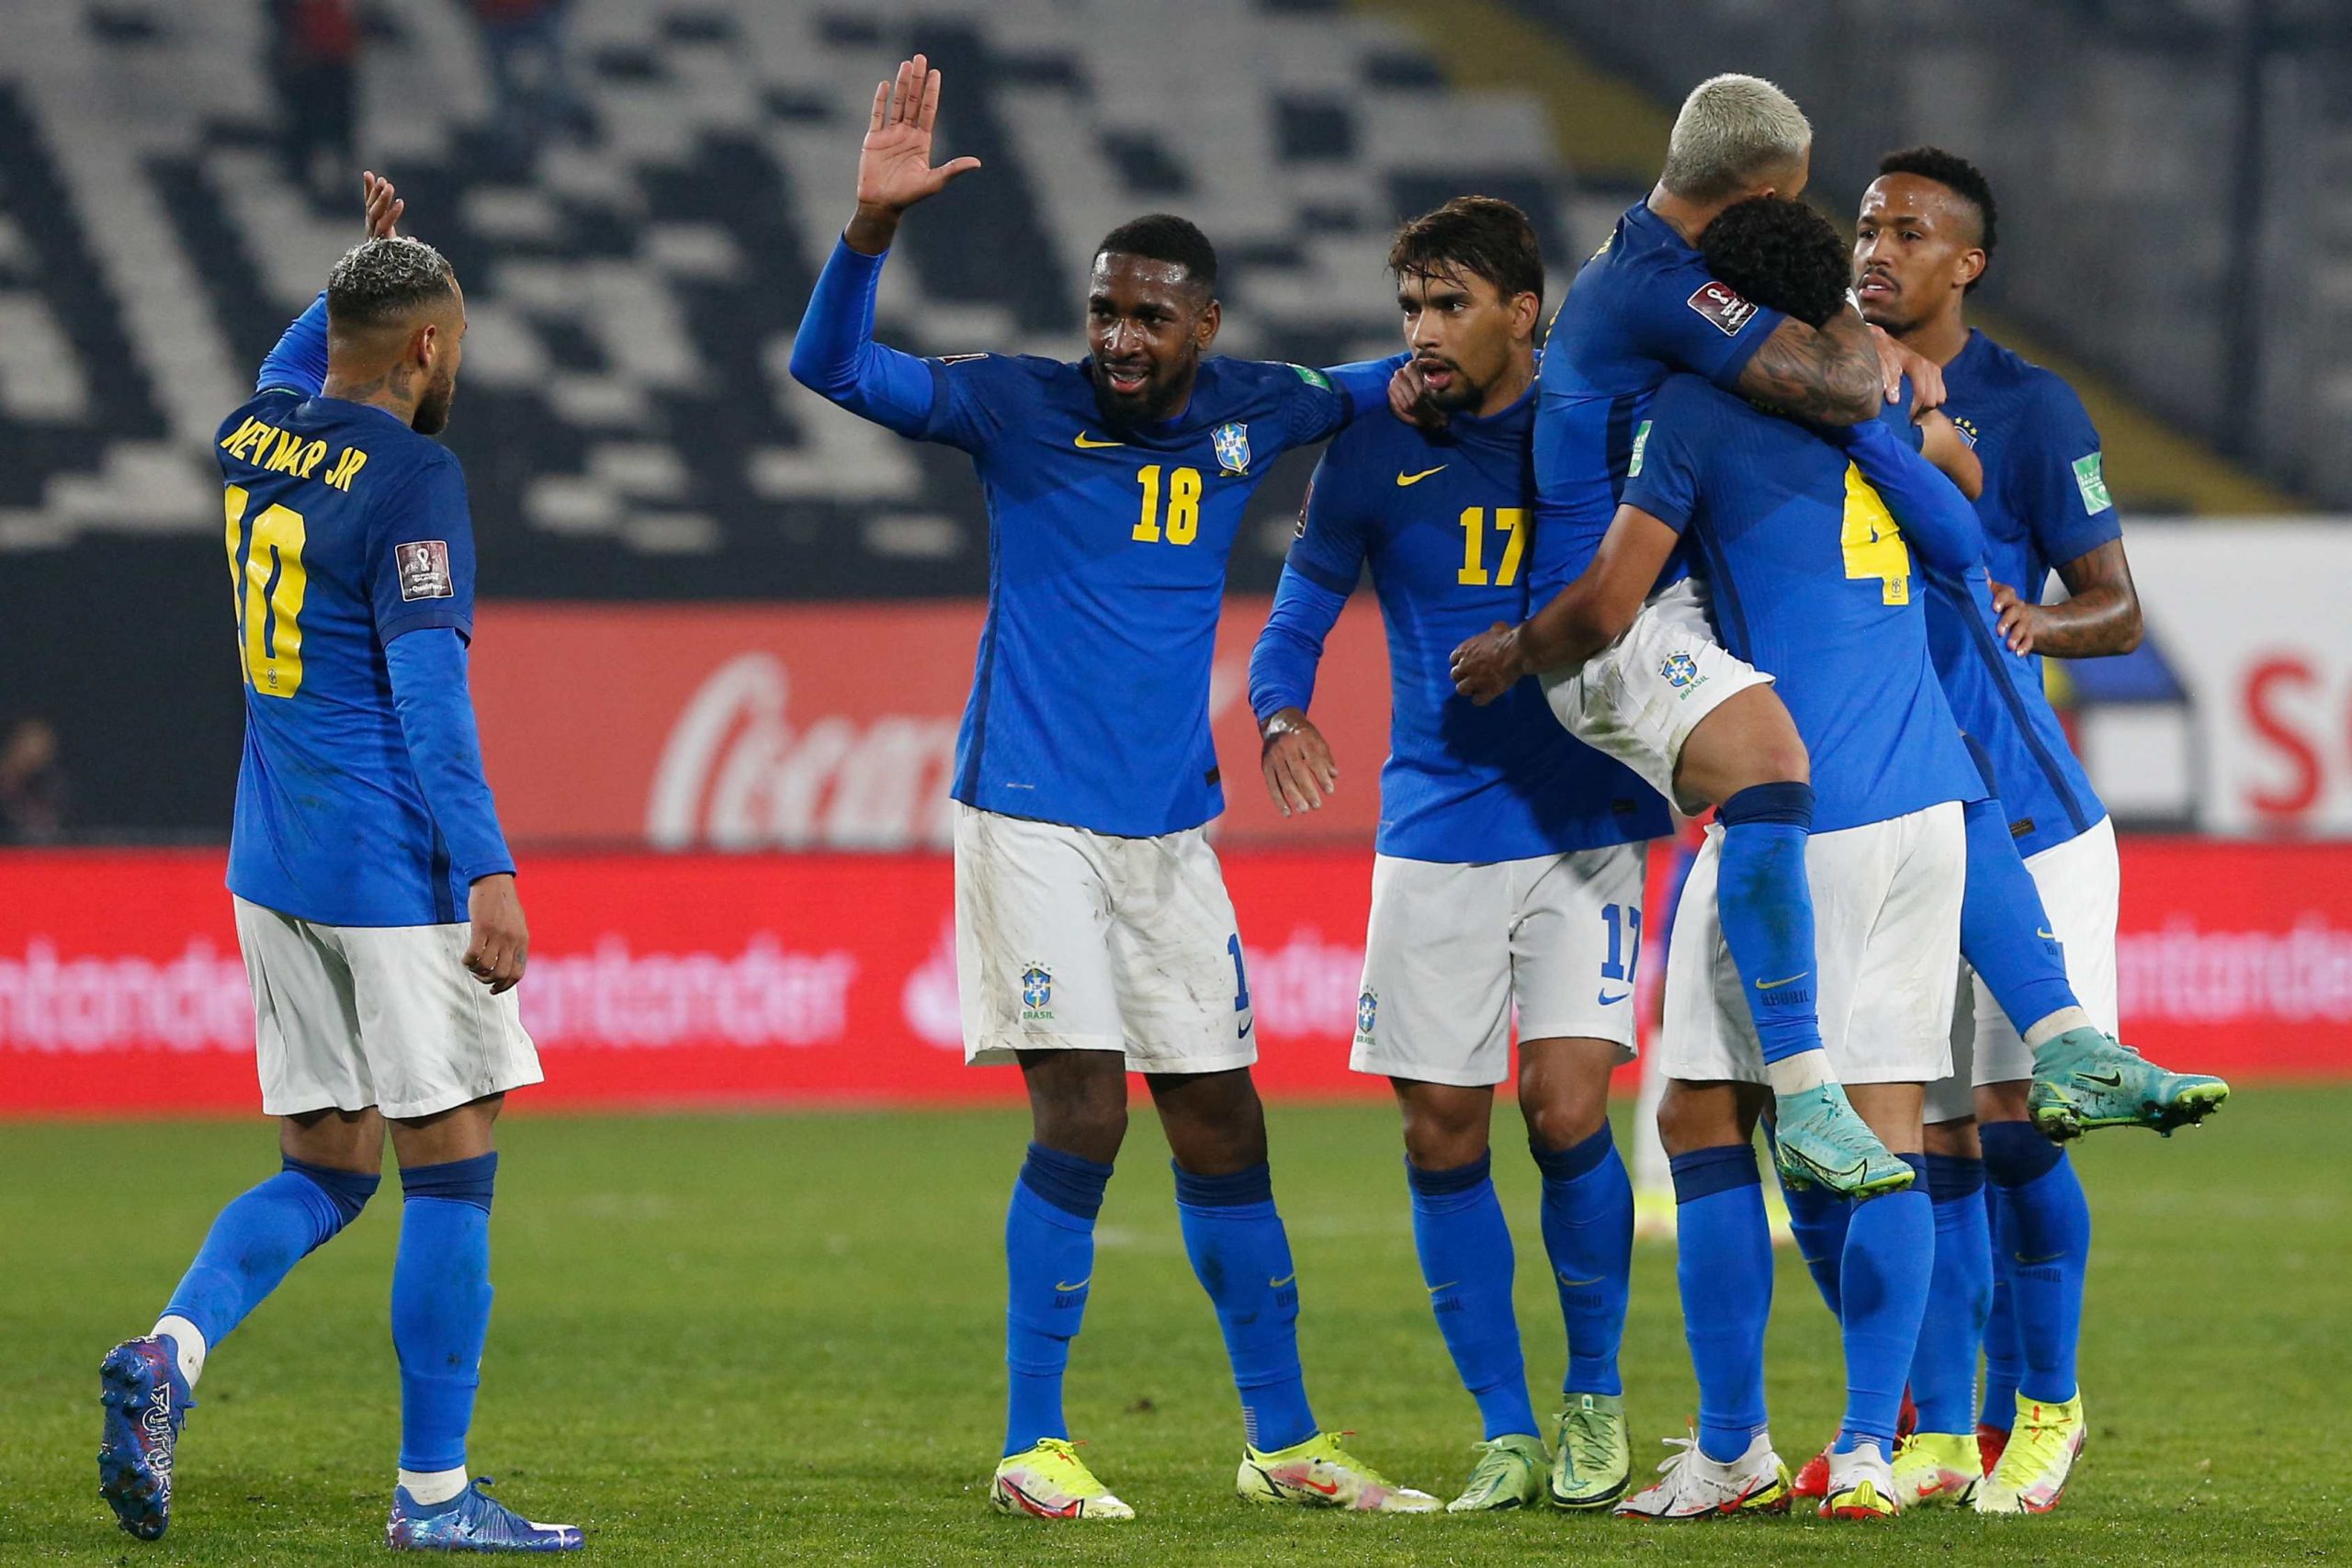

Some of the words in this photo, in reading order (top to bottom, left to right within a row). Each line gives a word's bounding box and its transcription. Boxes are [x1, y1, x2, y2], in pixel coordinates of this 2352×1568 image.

[220, 414, 328, 479] NEYMAR
[324, 446, 368, 492] JR
[1132, 465, 1204, 546] 18
[1840, 458, 1911, 606] 4
[1457, 506, 1532, 586] 17
[224, 484, 307, 698] 10
[1679, 675, 1711, 701] BRASIL
[1601, 903, 1642, 984] 17
[1023, 1010, 1055, 1020] BRASIL
